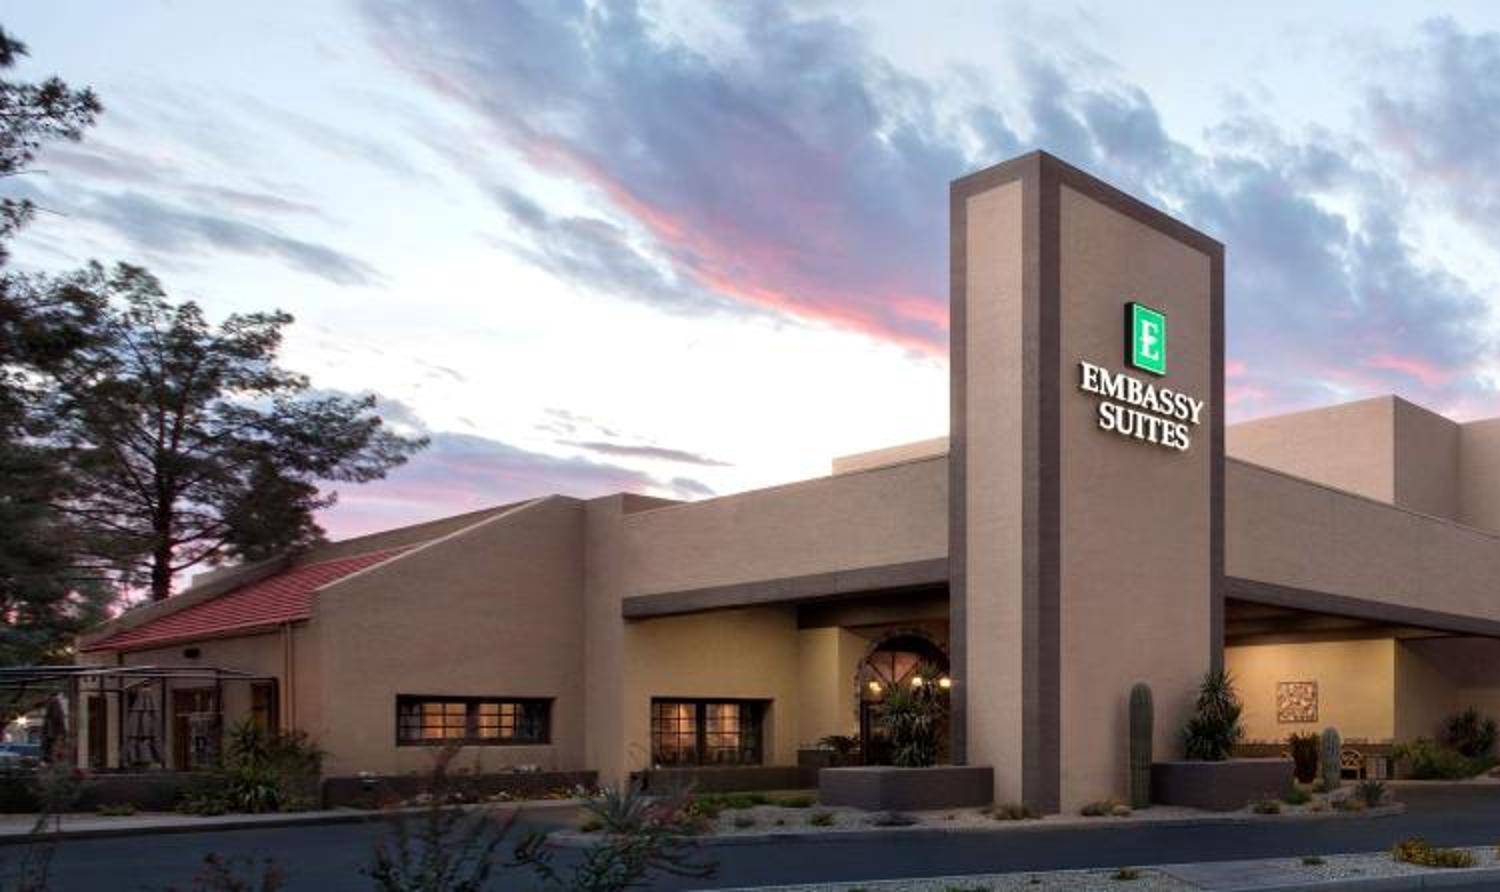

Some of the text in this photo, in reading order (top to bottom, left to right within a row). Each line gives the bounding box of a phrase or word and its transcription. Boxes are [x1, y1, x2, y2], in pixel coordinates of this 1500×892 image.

[1140, 319, 1159, 361] E
[1081, 360, 1203, 424] EMBASSY
[1098, 401, 1190, 452] SUITES
